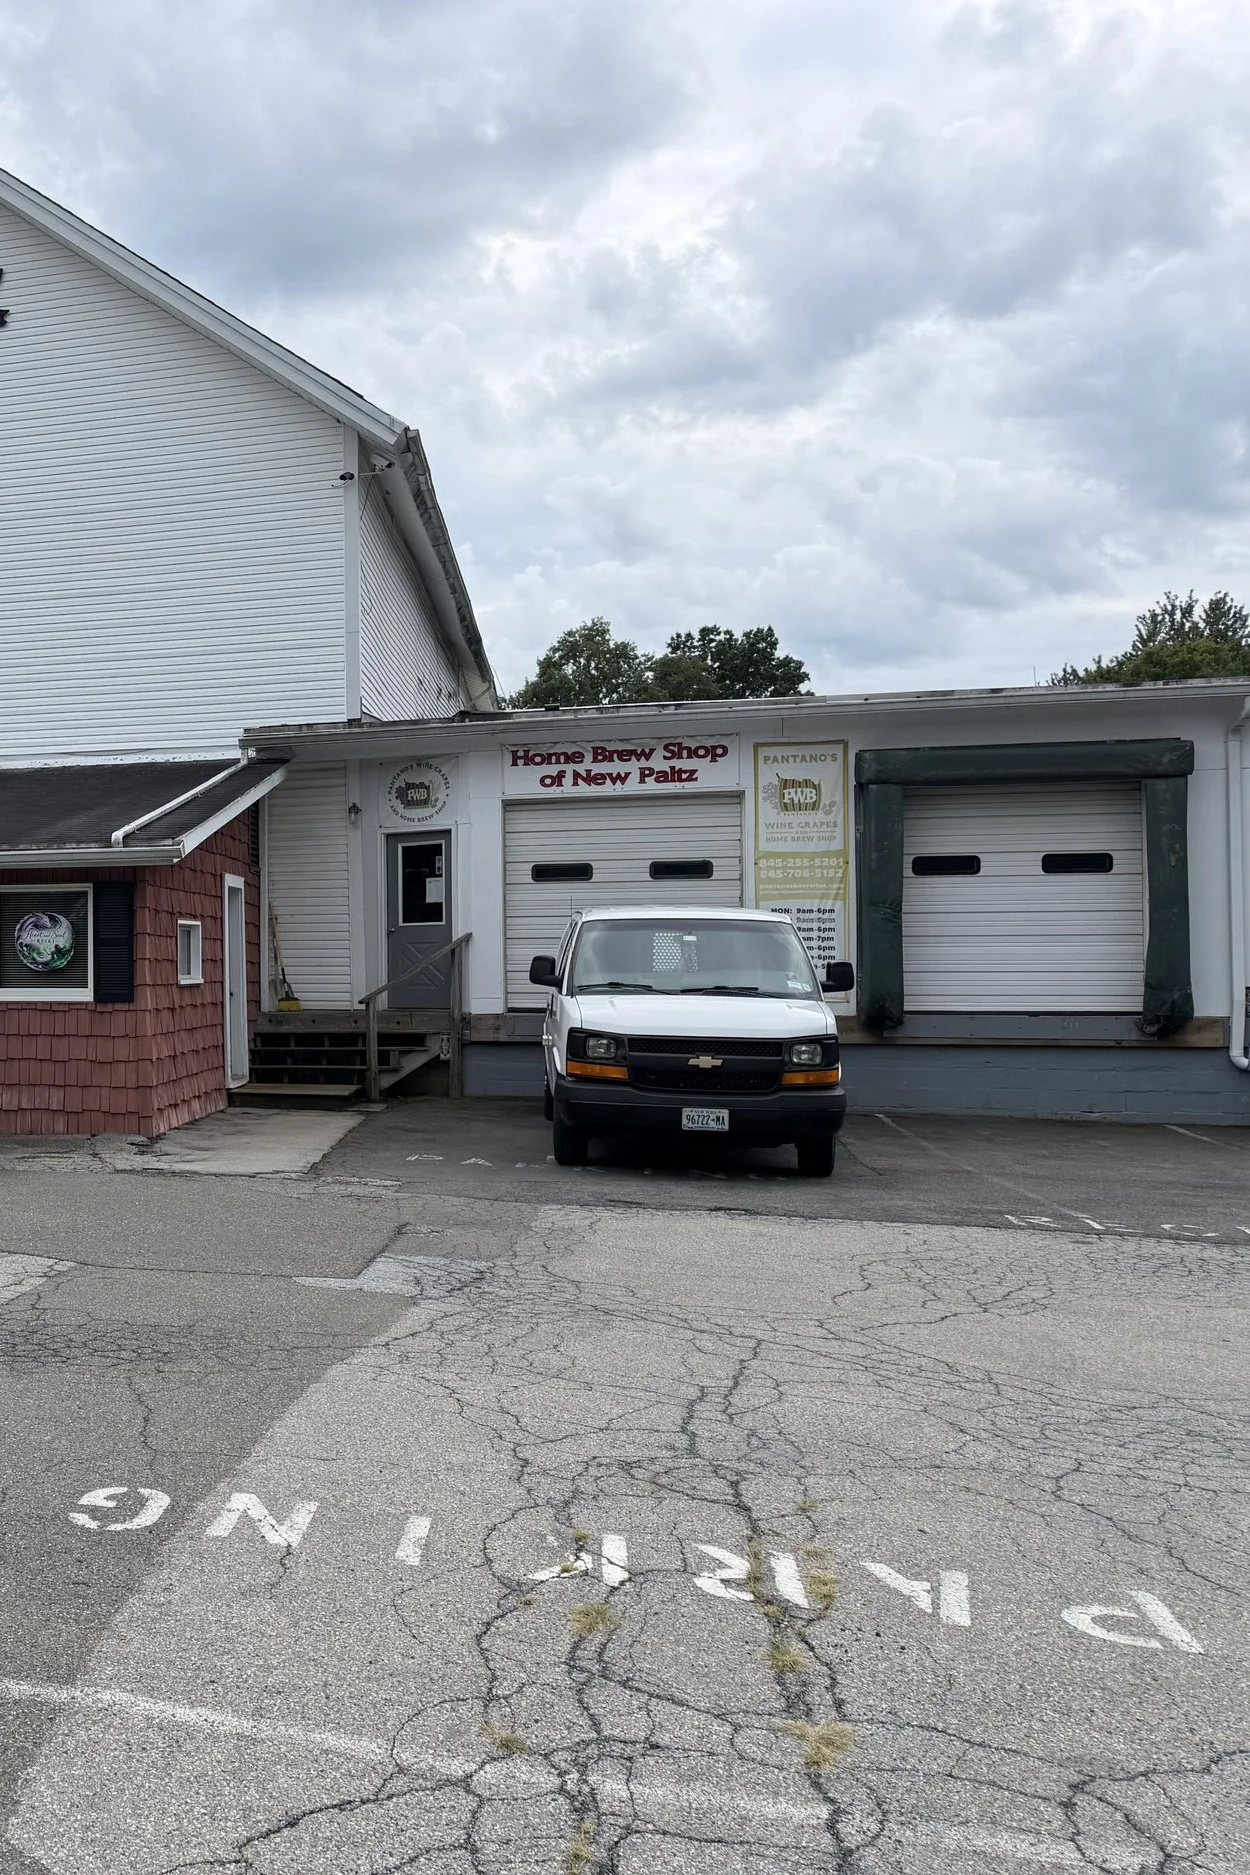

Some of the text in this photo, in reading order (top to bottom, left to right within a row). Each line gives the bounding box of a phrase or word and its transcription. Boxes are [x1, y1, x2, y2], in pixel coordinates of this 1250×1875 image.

[510, 742, 729, 767] Home Brew Shop
[763, 753, 838, 764] PANTANO'S
[415, 761, 434, 770] WINE
[540, 765, 699, 788] of New Paltz
[407, 788, 427, 801] PWB
[783, 787, 817, 804] PWB
[390, 800, 447, 822] AND HOME BREW SHOP
[765, 820, 838, 830] WINE GRAPES
[791, 835, 814, 843] BREW
[802, 935, 834, 943] am-7pm
